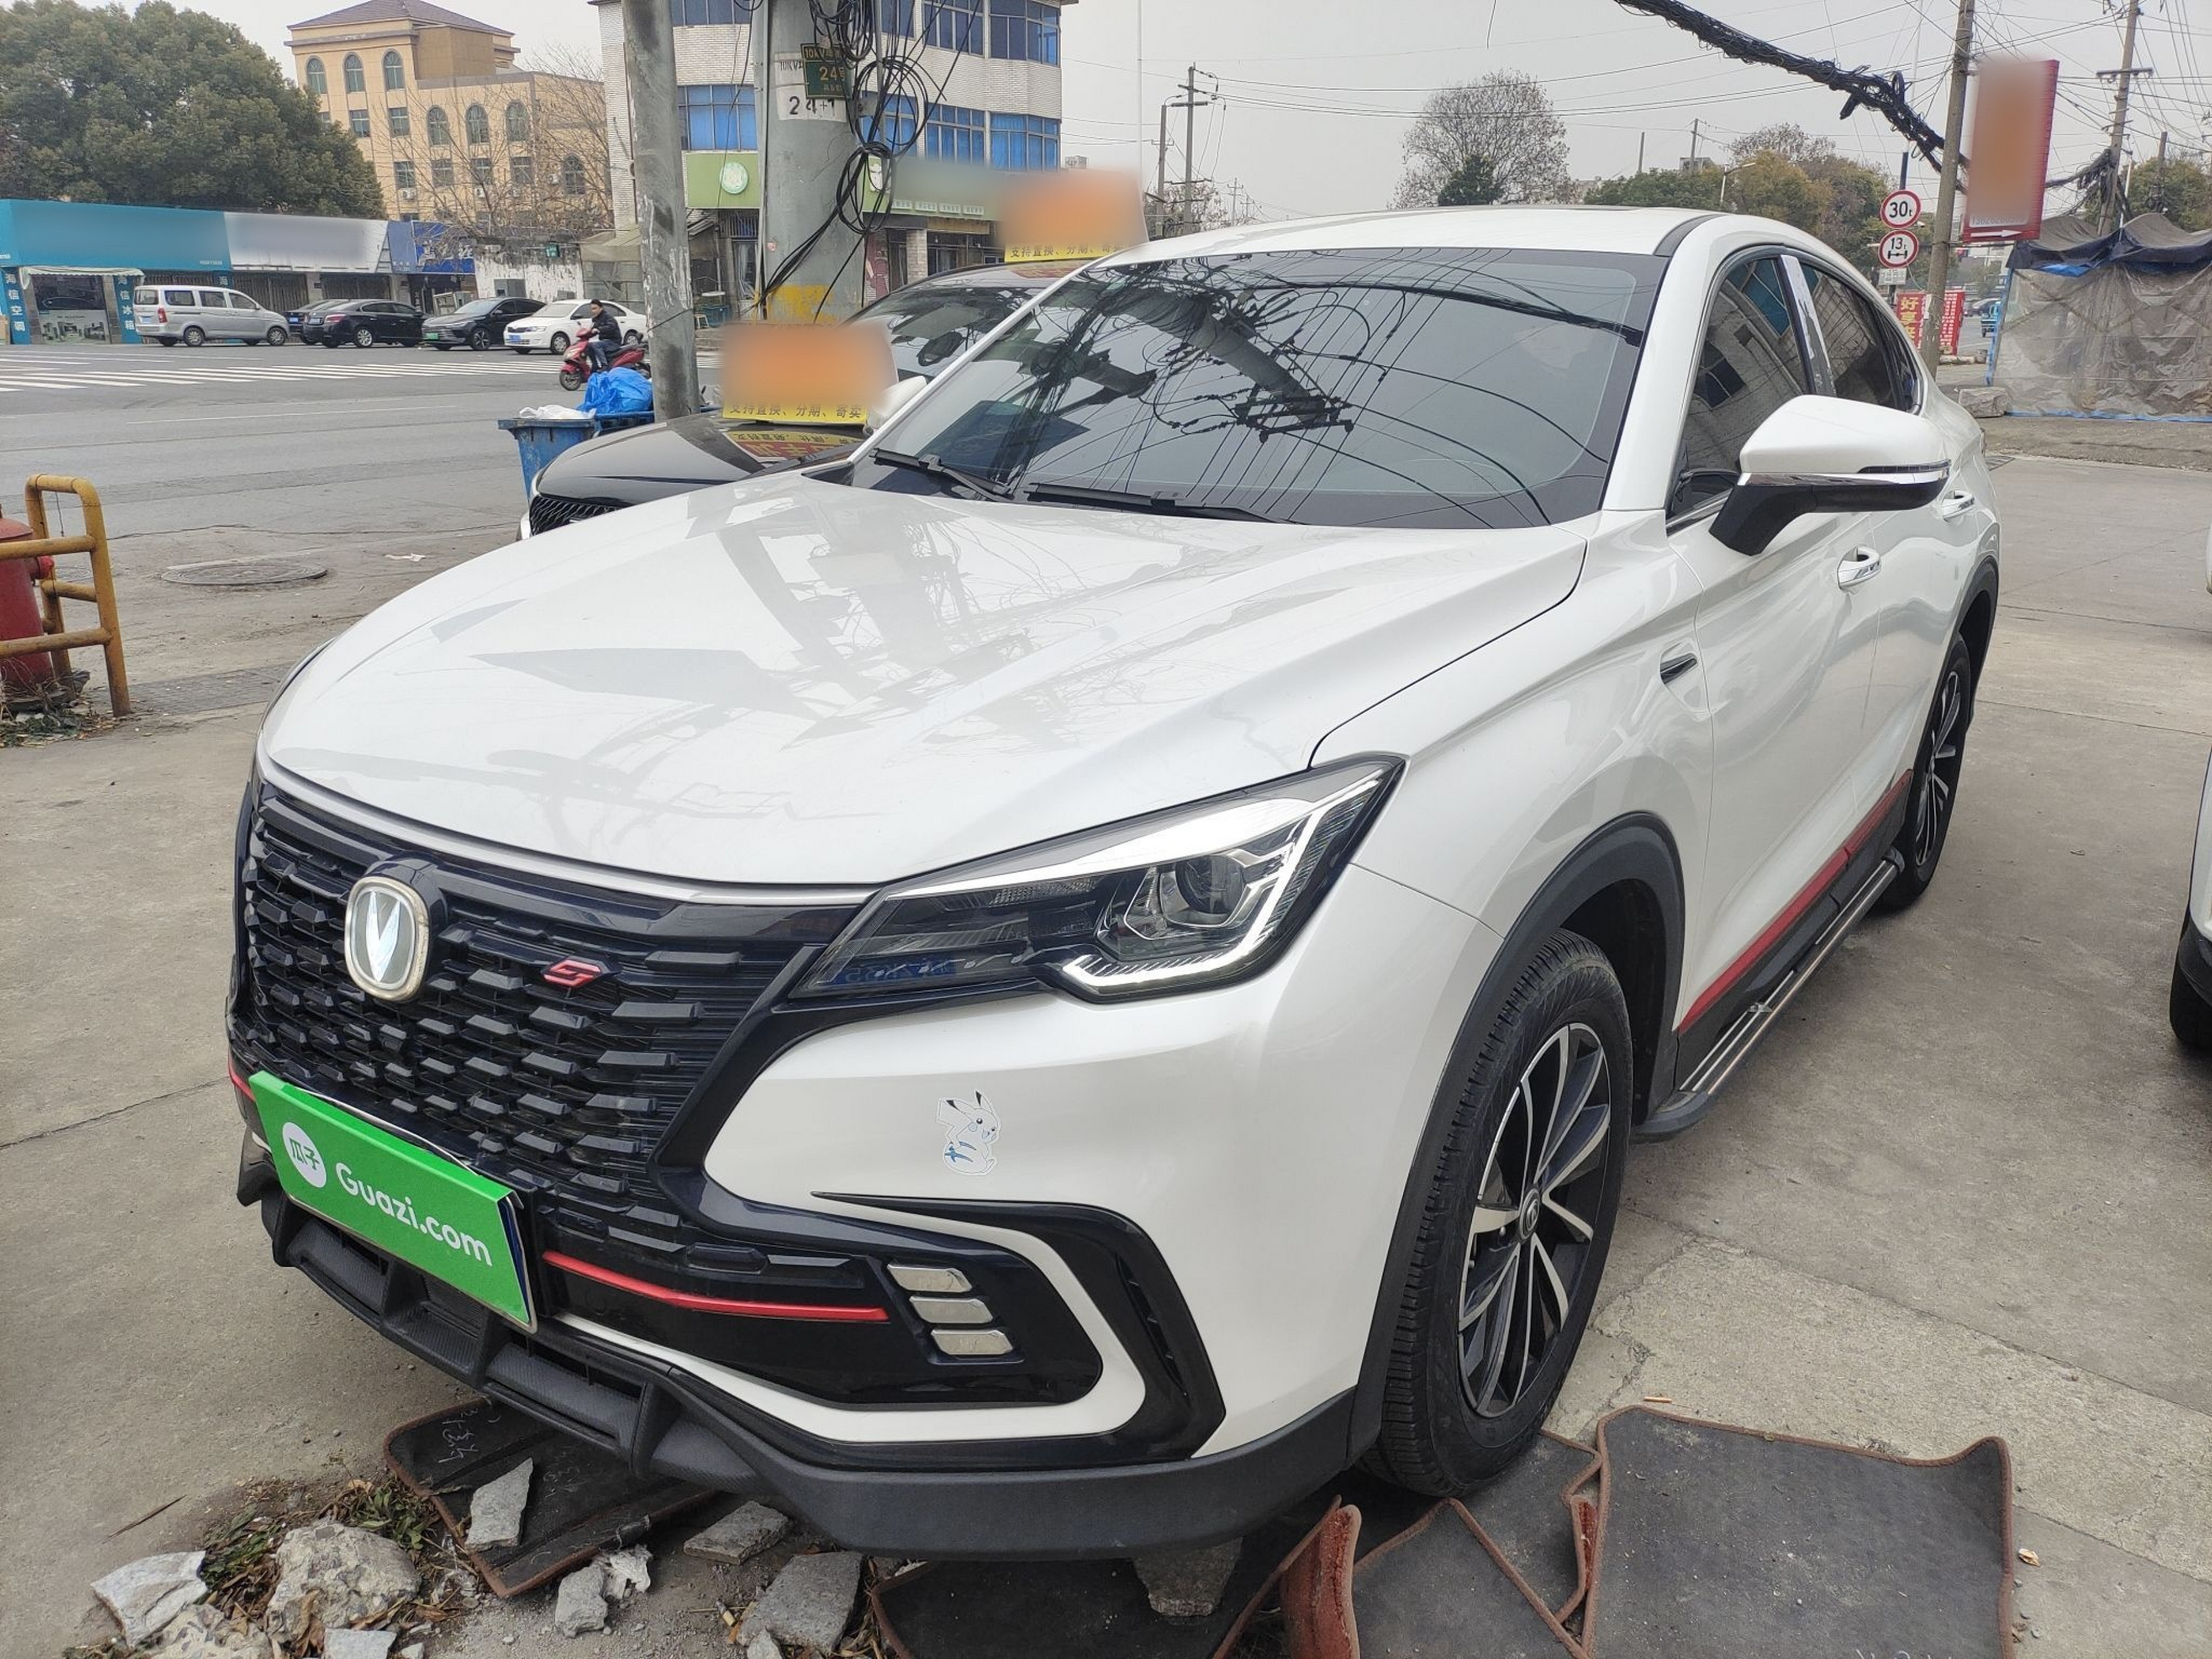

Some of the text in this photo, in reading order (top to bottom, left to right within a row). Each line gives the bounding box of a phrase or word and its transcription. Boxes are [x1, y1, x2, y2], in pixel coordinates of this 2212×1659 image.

[5, 273, 25, 332] 海信空调
[289, 1137, 320, 1171] 瓜子
[335, 1162, 493, 1267] Guazi.com
